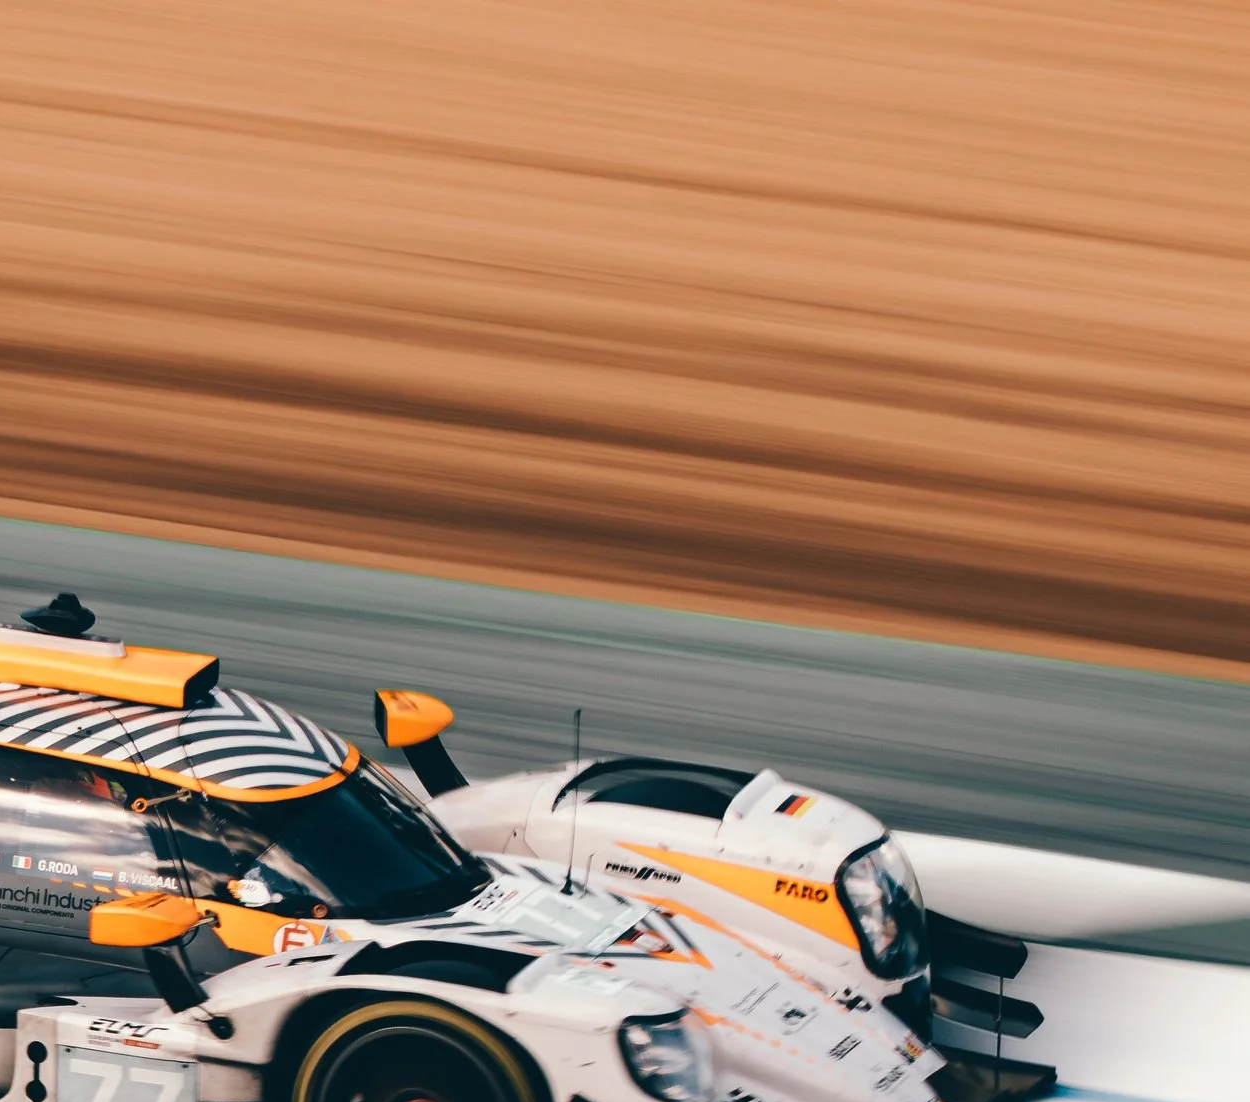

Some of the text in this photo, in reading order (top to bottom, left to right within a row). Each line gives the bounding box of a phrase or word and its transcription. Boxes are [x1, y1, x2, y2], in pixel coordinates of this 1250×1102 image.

[38, 859, 78, 877] G.RODA
[43, 886, 111, 912] Indust
[774, 879, 829, 903] FARO
[2, 903, 31, 914] ORIGINAL
[31, 907, 74, 919] COMPONENTS
[89, 1018, 169, 1037] ELMS
